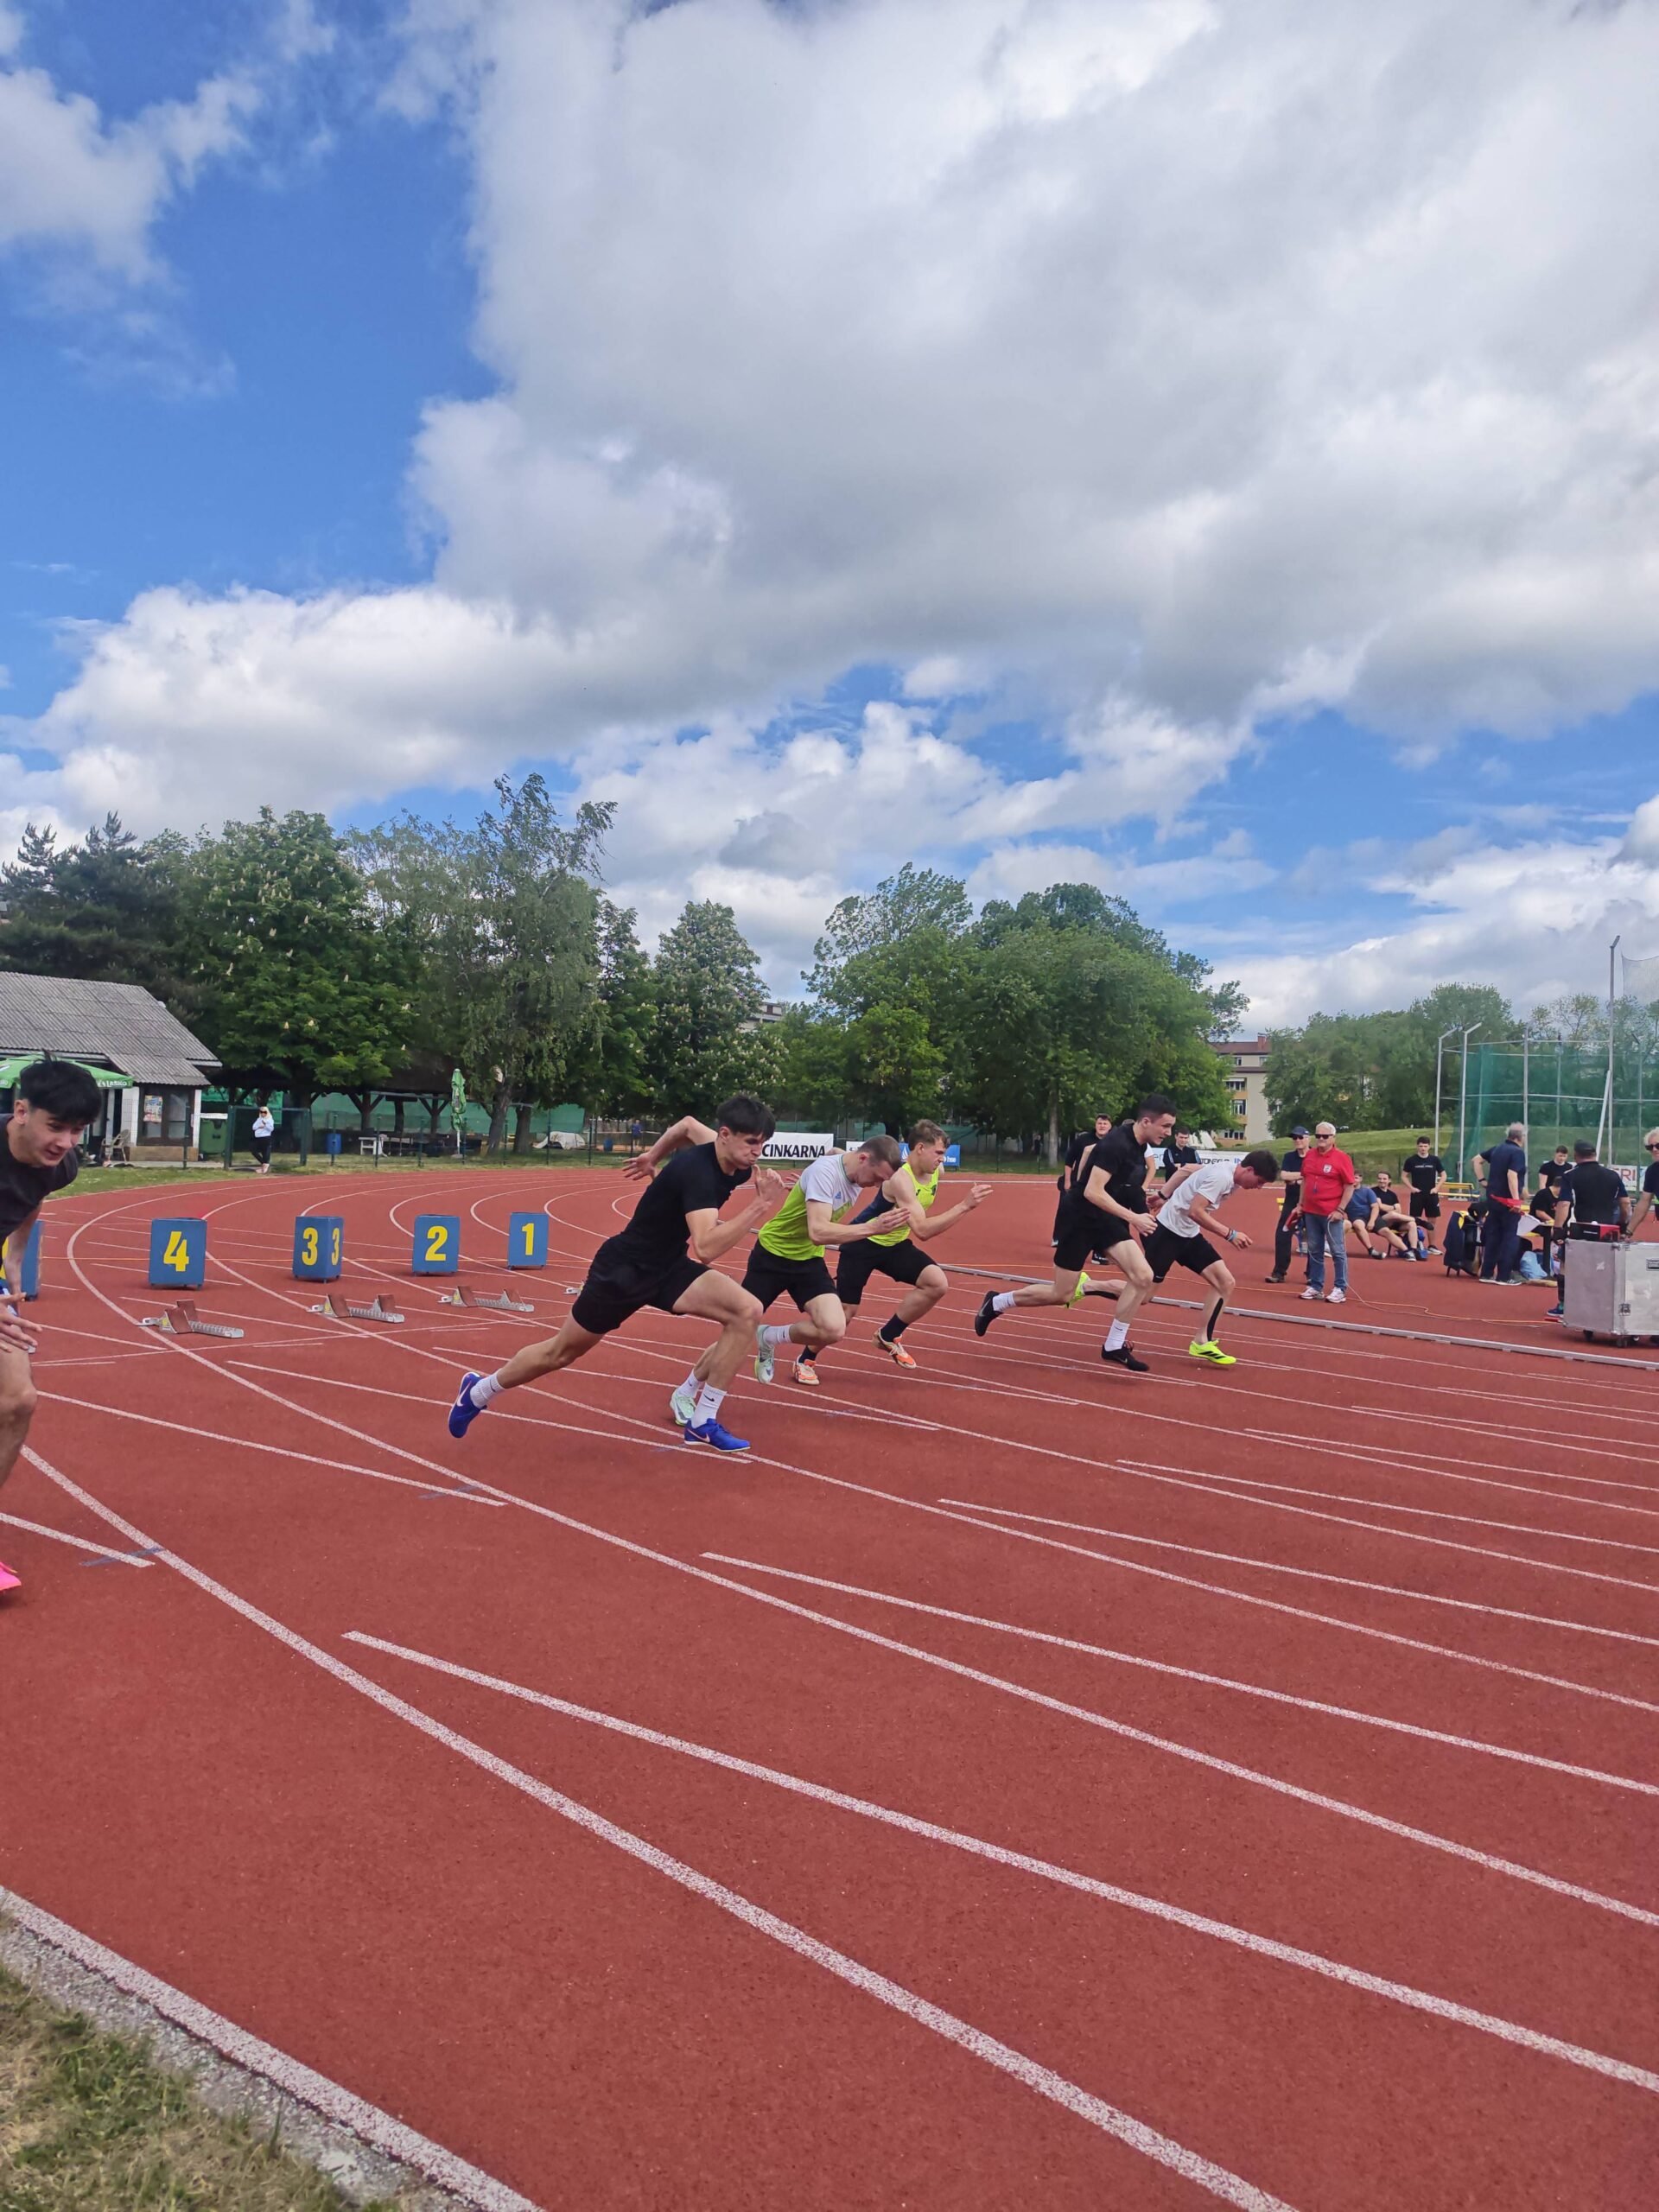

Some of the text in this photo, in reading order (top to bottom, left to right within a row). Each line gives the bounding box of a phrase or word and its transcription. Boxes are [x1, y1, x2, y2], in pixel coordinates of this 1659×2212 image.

[761, 1144, 825, 1159] CINKARNA
[163, 1231, 189, 1272] 4
[302, 1227, 319, 1266] 3
[331, 1227, 340, 1266] 3
[424, 1225, 449, 1262] 2
[521, 1223, 535, 1256] 1
